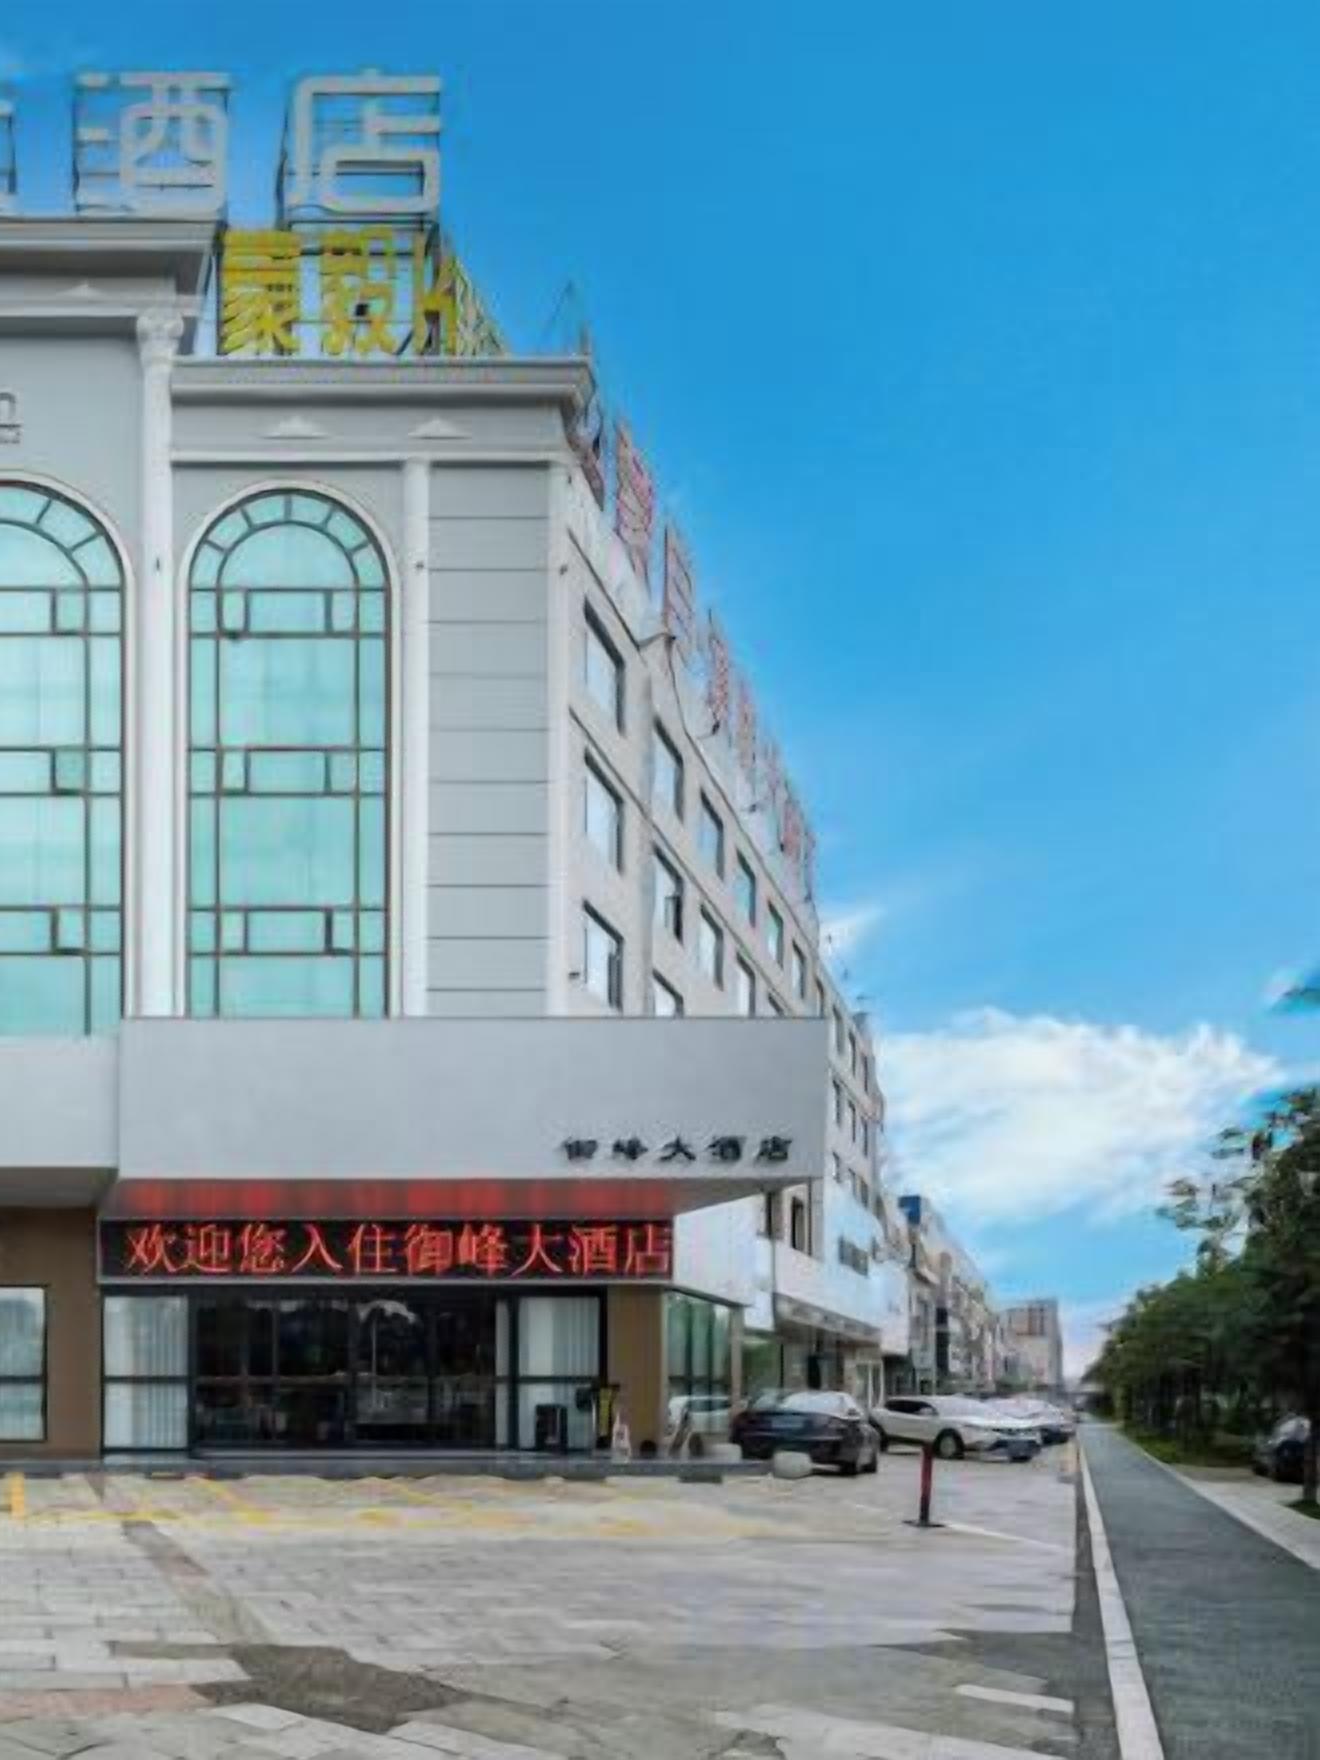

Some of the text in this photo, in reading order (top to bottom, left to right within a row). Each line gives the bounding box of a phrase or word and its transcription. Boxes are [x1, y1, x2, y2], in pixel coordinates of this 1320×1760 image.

[125, 1222, 671, 1277] 欢迎您入住御峰大酒店
